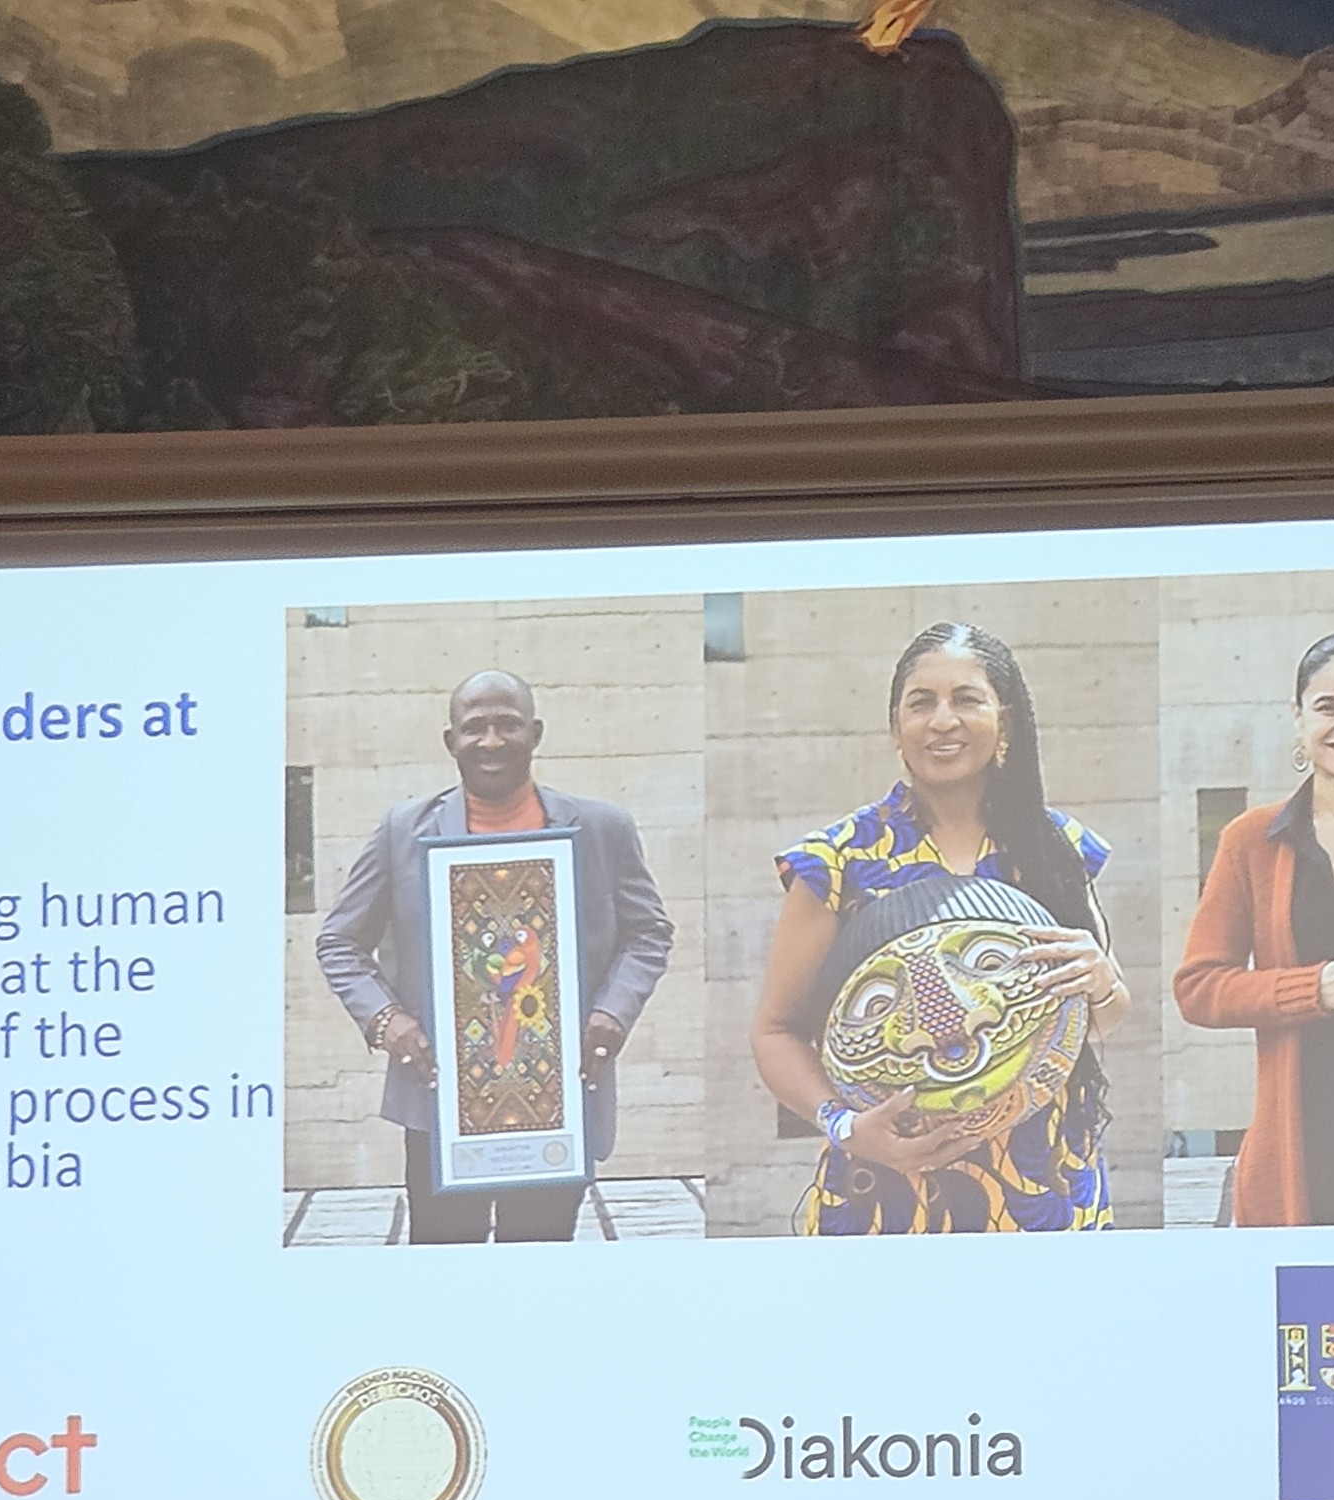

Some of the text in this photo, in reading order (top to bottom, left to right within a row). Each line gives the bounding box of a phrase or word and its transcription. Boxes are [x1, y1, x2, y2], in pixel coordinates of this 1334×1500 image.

[143, 693, 197, 737] at
[42, 882, 223, 927] human
[1, 953, 50, 994] at
[68, 946, 154, 992] the
[34, 1011, 121, 1058] the
[10, 1085, 209, 1136] process
[231, 1073, 272, 1118] in
[357, 1383, 441, 1408] DERECHOS
[392, 1370, 450, 1396] NACIONAL
[740, 1413, 1022, 1479] Diakonia
